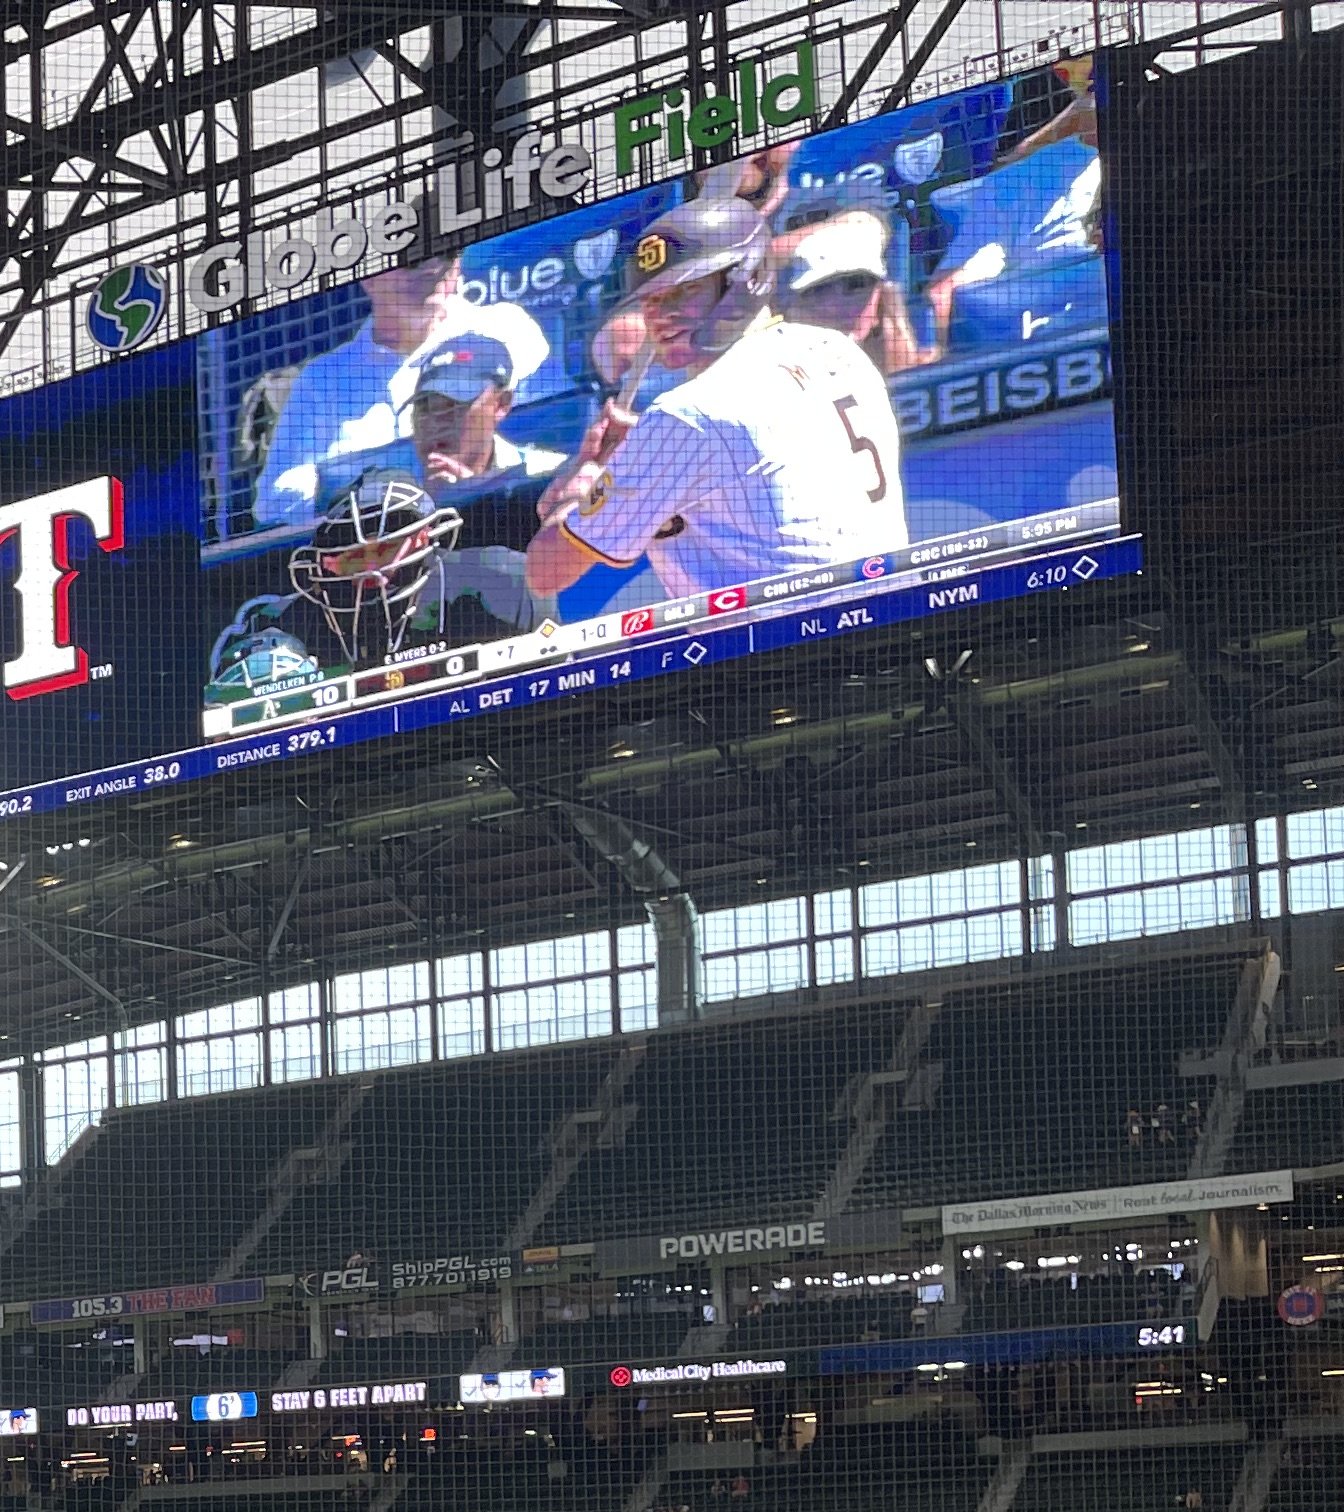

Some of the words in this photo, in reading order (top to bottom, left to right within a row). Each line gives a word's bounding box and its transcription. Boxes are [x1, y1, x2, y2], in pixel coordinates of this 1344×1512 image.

[188, 198, 419, 314] Globe
[430, 129, 596, 235] Life
[614, 39, 818, 177] Field
[832, 394, 887, 504] 5
[1055, 516, 1077, 532] PM
[393, 645, 427, 663] MYERS
[65, 786, 91, 803] EXIT
[94, 775, 137, 796] ANGLE
[143, 762, 180, 784] 38.0
[217, 743, 281, 769] DISTANCE
[287, 726, 337, 752] 379.1
[450, 700, 470, 716] AL
[479, 687, 514, 709] DET
[528, 679, 550, 697] 17
[558, 669, 595, 691] MIN
[609, 661, 631, 679] 14
[661, 652, 673, 668] F
[801, 618, 827, 636] NL
[837, 607, 873, 630] ATL
[928, 583, 979, 609] NYM
[1026, 565, 1067, 589] 6:10
[253, 676, 305, 697] WENDELKEN
[312, 686, 339, 707] 10
[445, 656, 464, 675] 0
[978, 1208, 1013, 1223] Dallas
[1073, 1199, 1107, 1214] News
[660, 1222, 825, 1259] POWERADE
[322, 1268, 379, 1292] PGL
[392, 1256, 511, 1276] ShipPGL.com
[71, 1296, 122, 1318] 105.3
[127, 1292, 166, 1312] THE
[171, 1286, 217, 1308] FAN
[1138, 1325, 1184, 1346] 5:41
[632, 1367, 684, 1383] Medical
[683, 1364, 711, 1381] City
[712, 1359, 787, 1377] Healthcare
[67, 1407, 87, 1426] DO
[90, 1404, 132, 1424] YOUR
[271, 1391, 310, 1412] STAY
[313, 1389, 327, 1408] 6
[329, 1386, 368, 1407] FEET
[371, 1382, 427, 1405] APART
